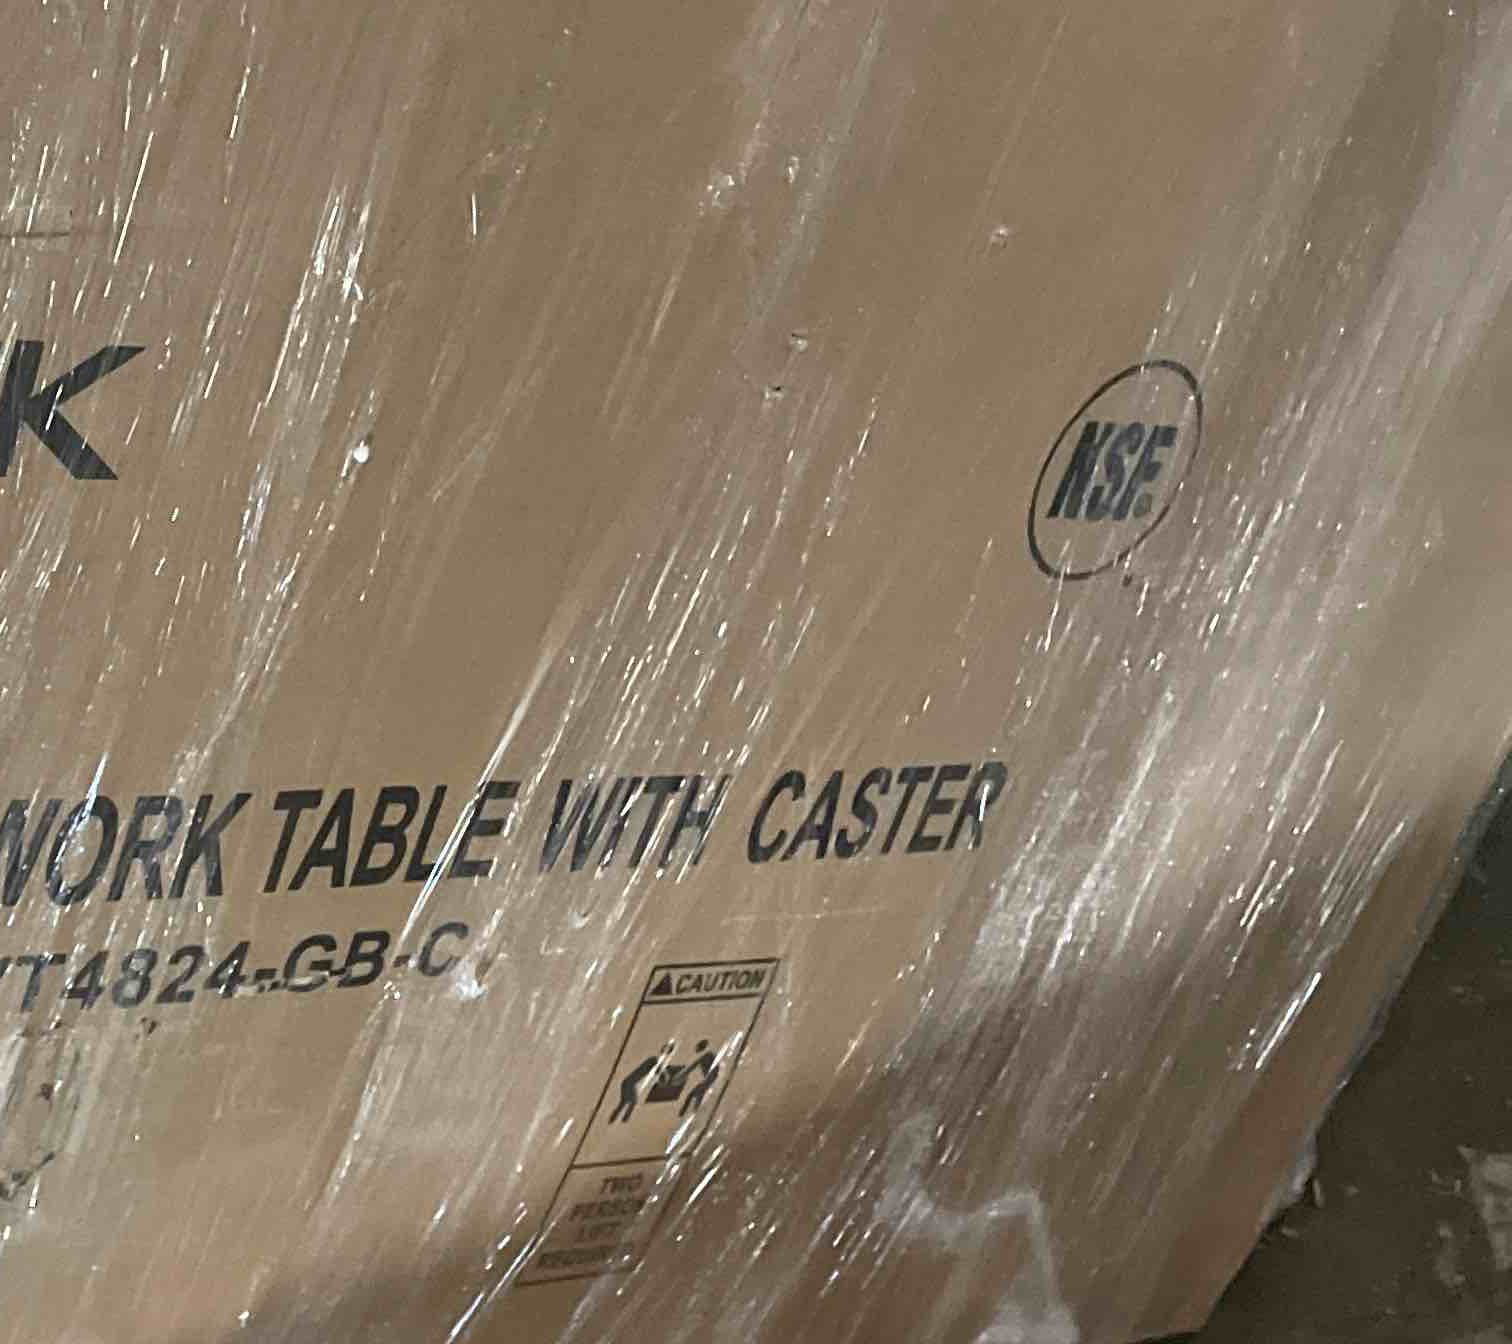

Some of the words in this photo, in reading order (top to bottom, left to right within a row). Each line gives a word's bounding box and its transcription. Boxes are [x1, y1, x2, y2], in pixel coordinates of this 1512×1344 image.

[1045, 419, 1178, 522] NSF
[260, 776, 521, 894] TABLE
[537, 769, 732, 874] WITH
[745, 760, 1009, 865] CASTER
[675, 968, 767, 995] CAUTION
